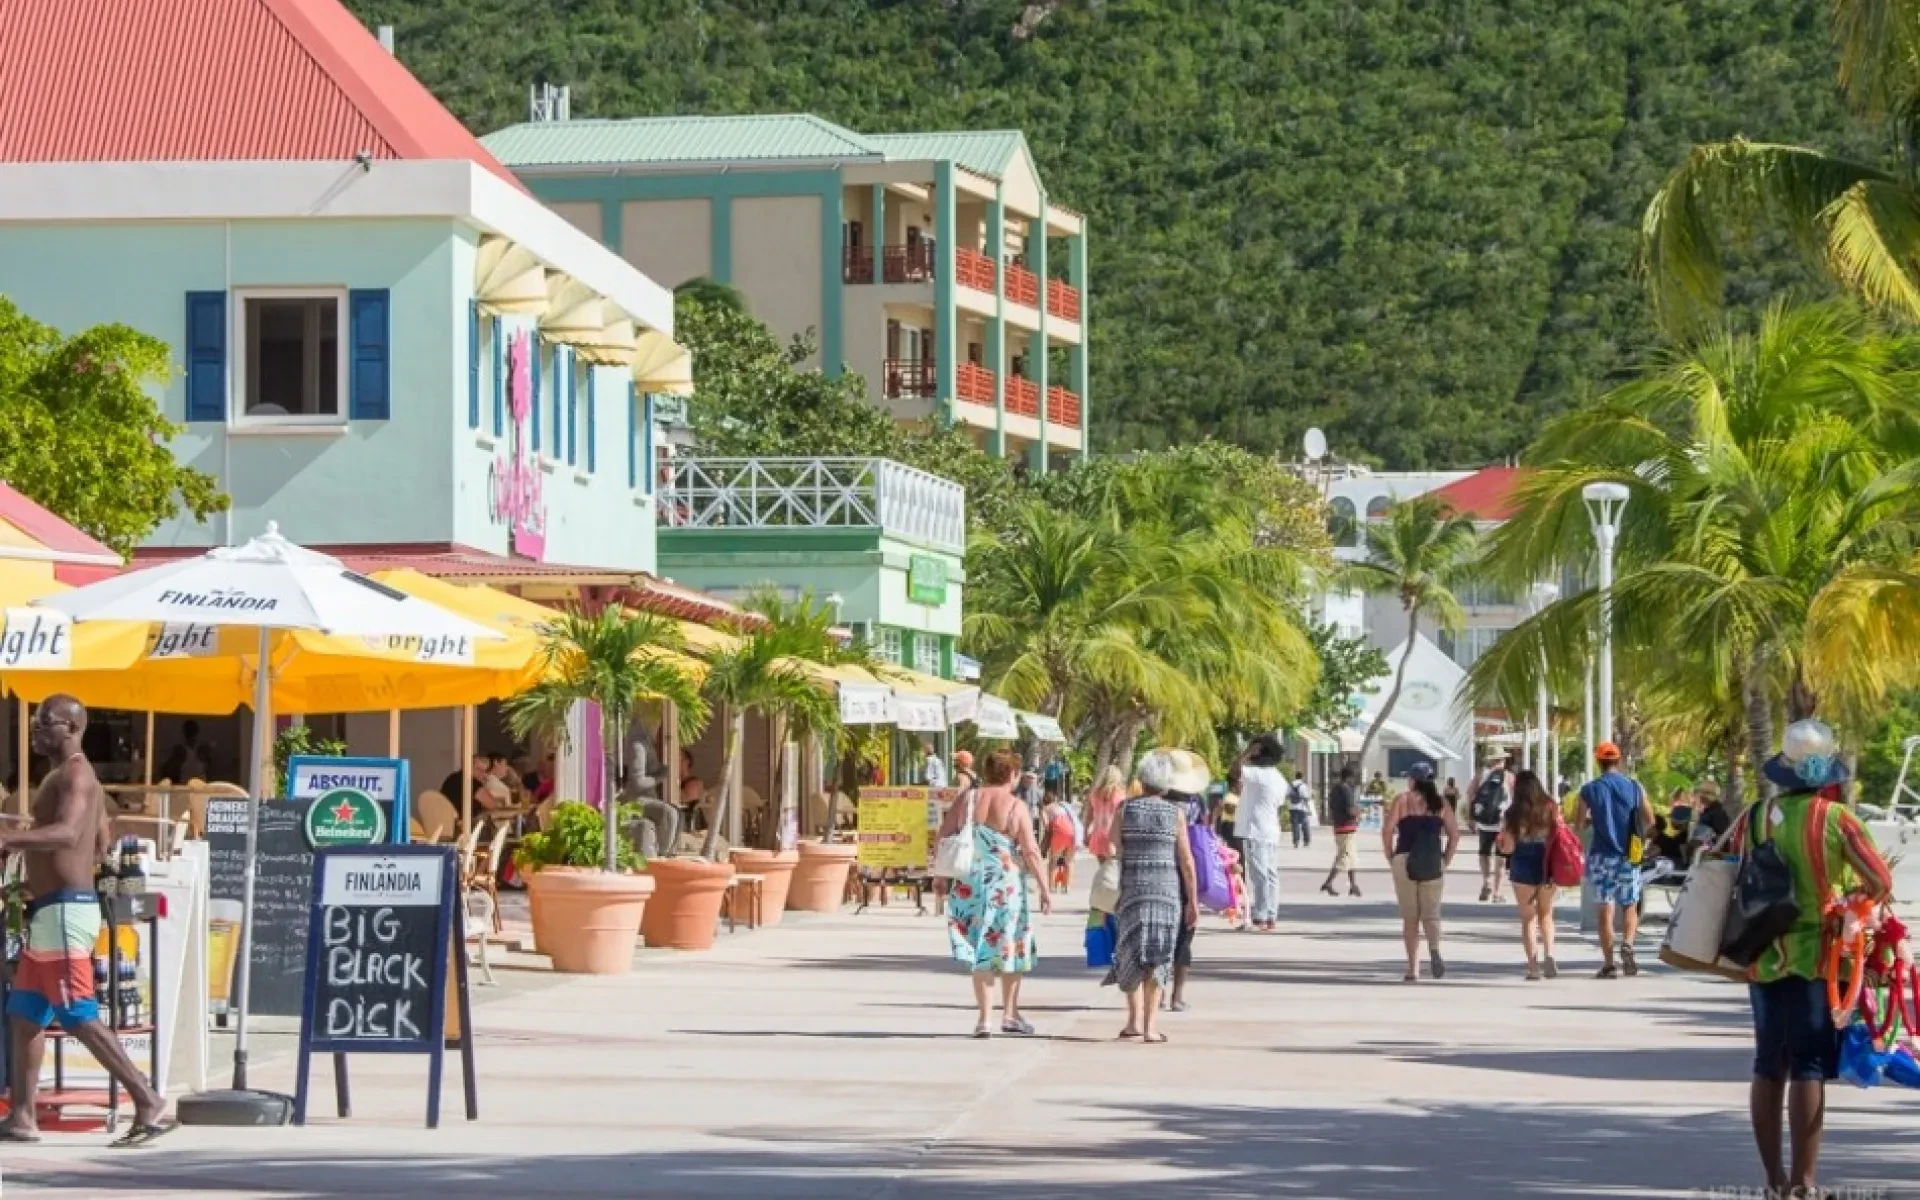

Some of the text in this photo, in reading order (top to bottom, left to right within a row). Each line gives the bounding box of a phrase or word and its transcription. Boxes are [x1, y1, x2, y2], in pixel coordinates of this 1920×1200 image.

[158, 589, 278, 610] FINLANDIA
[314, 825, 372, 838] Heineken
[345, 872, 421, 891] FINLANDIA
[327, 946, 428, 990] BLACK
